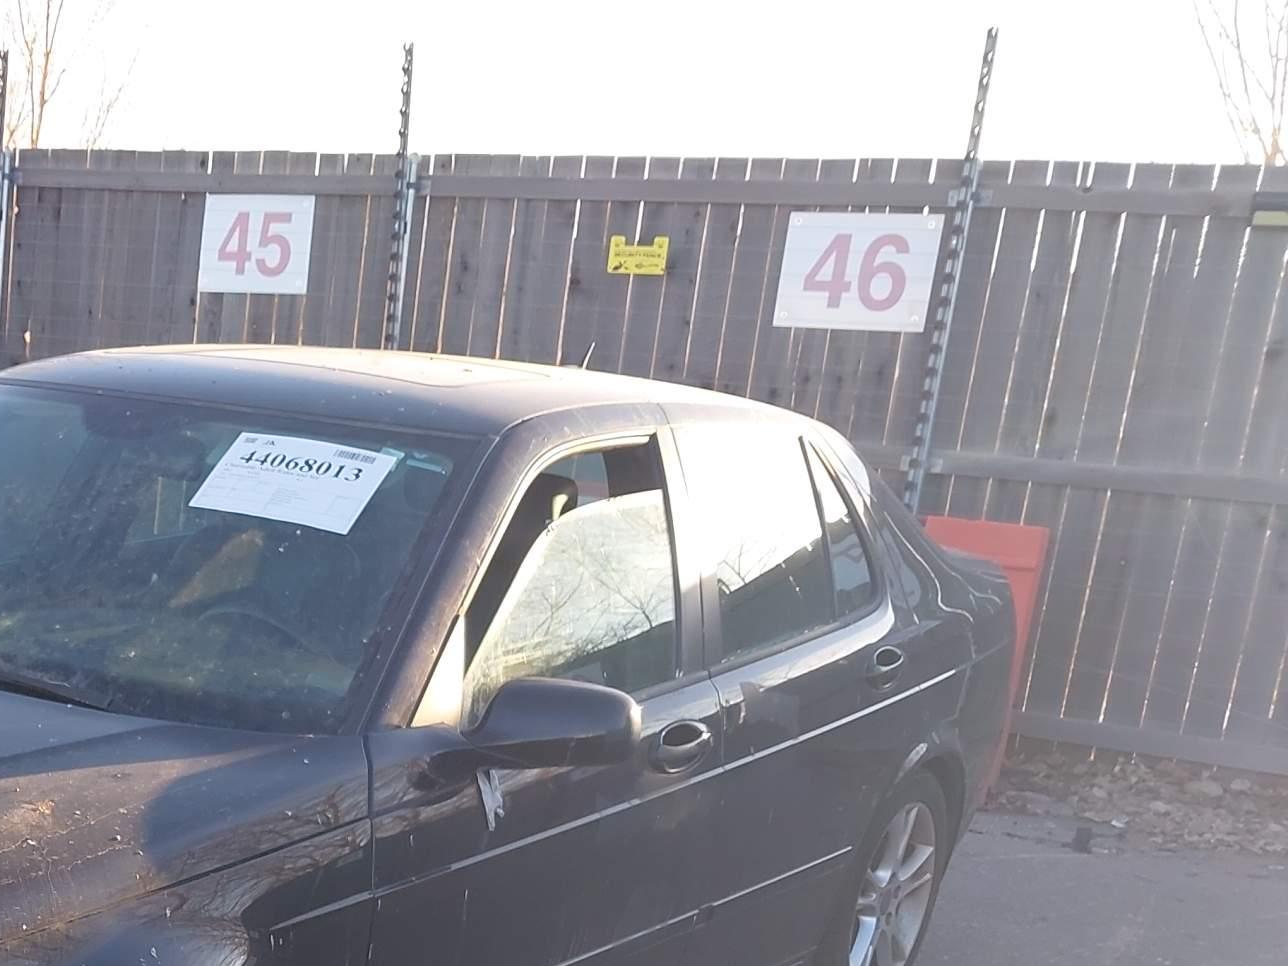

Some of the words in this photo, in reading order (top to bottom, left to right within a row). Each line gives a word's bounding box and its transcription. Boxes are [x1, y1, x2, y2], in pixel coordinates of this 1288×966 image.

[217, 211, 292, 277] 45
[802, 232, 911, 312] 46
[239, 450, 364, 482] 44068013
